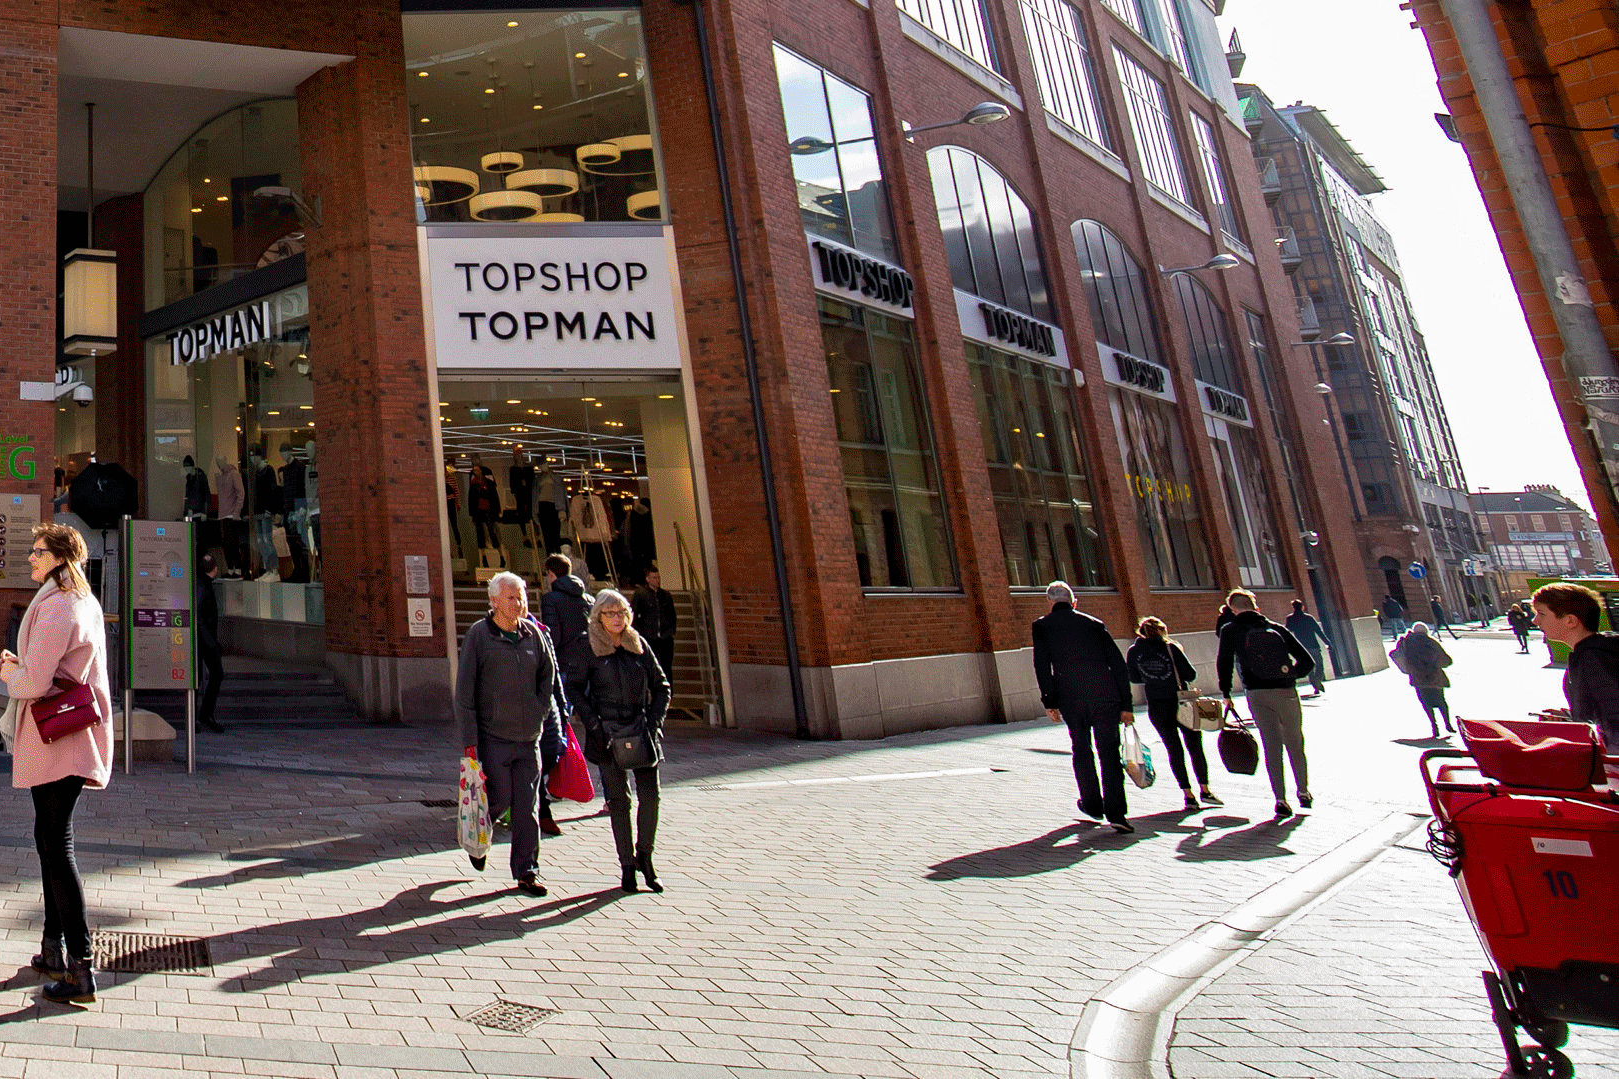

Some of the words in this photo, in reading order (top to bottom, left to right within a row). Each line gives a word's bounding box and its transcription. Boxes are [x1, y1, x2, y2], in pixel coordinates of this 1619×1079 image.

[455, 261, 649, 294] TOPSHOP
[812, 241, 914, 308] TOPSHOP
[166, 300, 272, 367] TOPMAN
[459, 310, 656, 342] TOPMAN
[978, 303, 1057, 358] TOPMAN
[1112, 352, 1166, 393] TOPSHOP
[8, 445, 36, 481] G
[1124, 472, 1192, 505] TOPSHOP
[1543, 868, 1579, 899] 10
